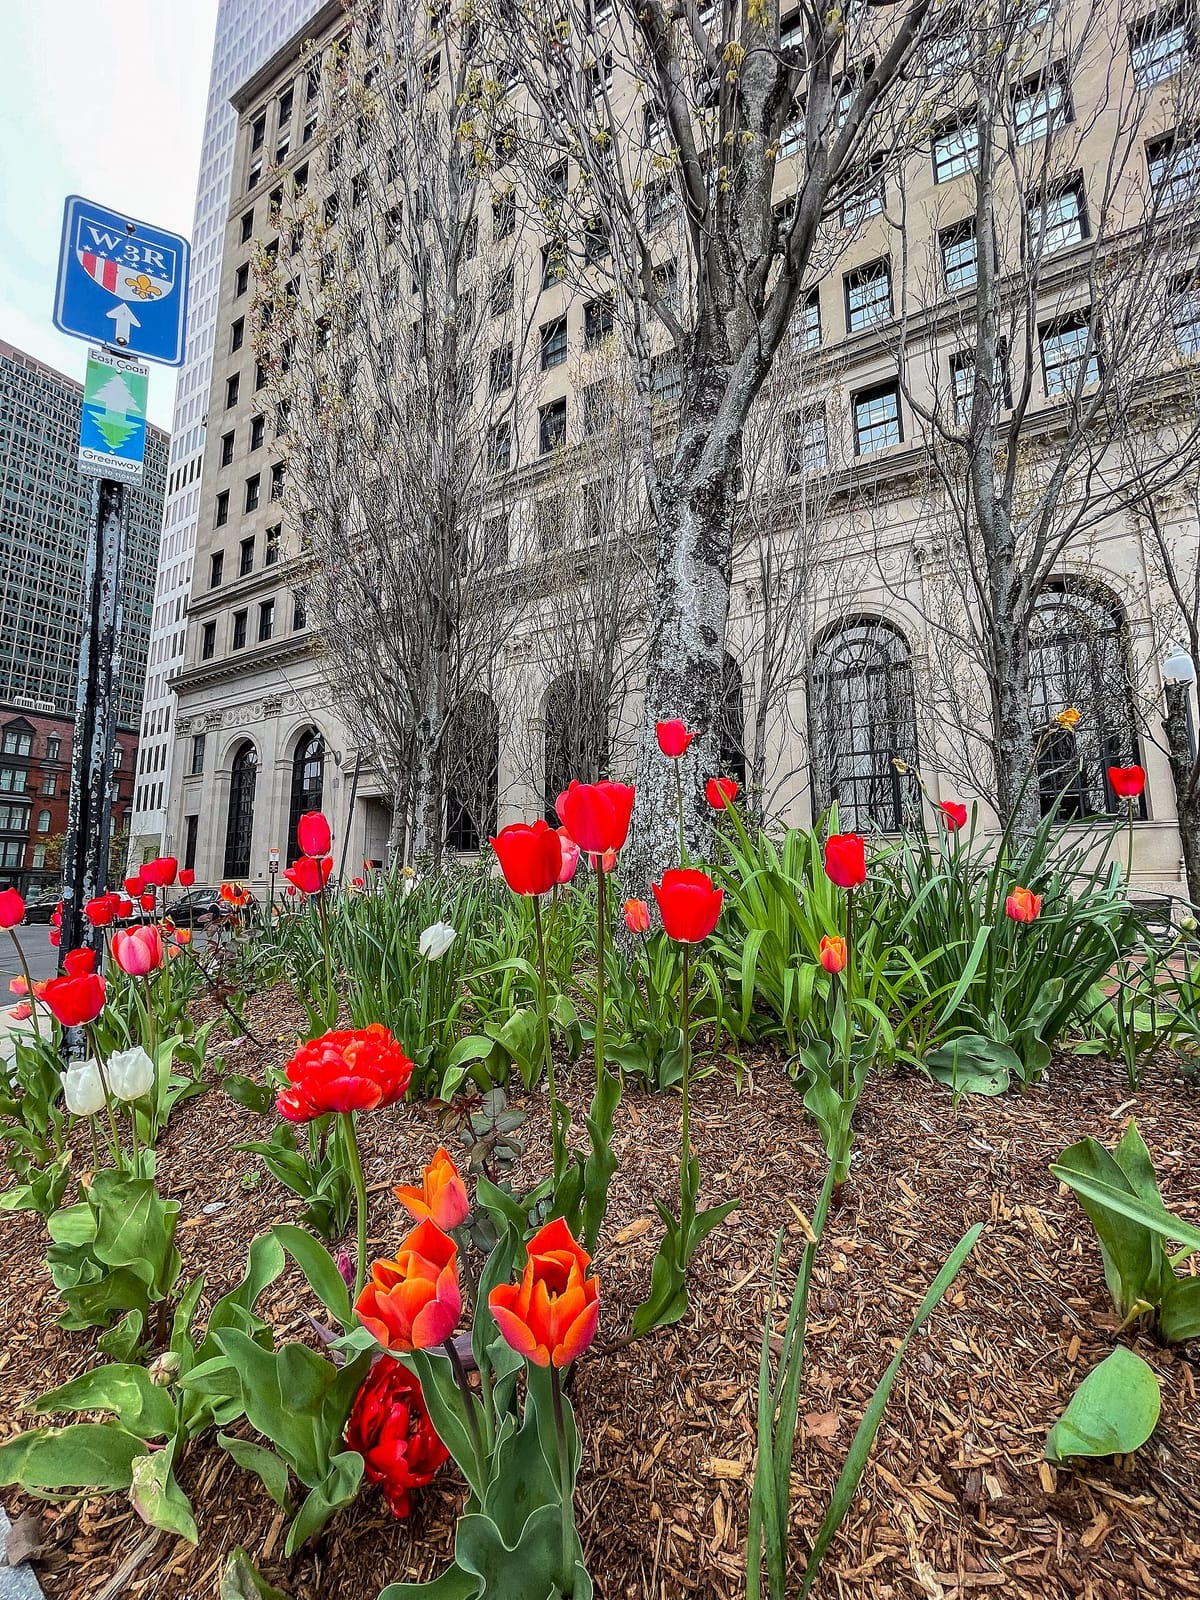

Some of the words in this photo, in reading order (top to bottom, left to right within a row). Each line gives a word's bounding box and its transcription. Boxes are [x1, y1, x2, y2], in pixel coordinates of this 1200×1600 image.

[87, 225, 167, 270] W3R
[91, 351, 113, 365] East
[116, 360, 147, 375] Coast
[83, 450, 140, 472] Greenway
